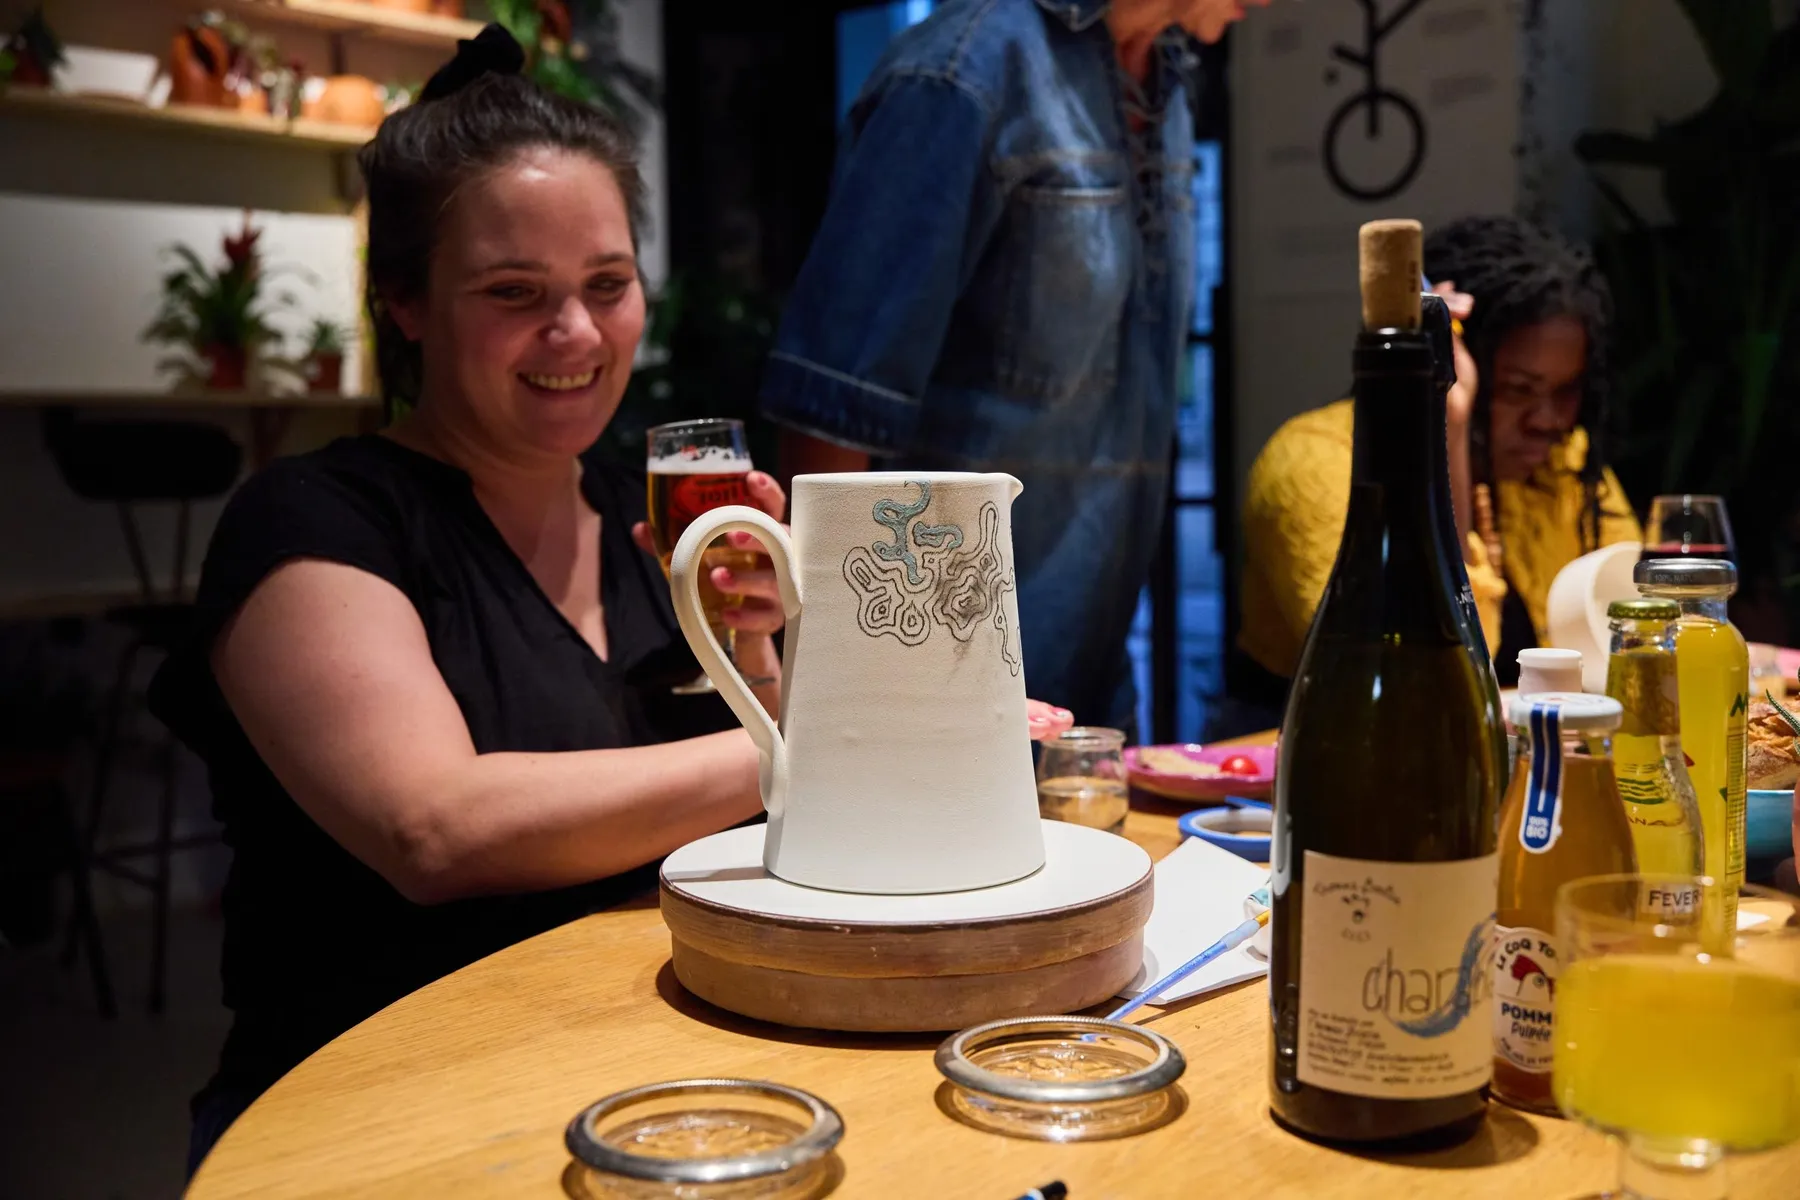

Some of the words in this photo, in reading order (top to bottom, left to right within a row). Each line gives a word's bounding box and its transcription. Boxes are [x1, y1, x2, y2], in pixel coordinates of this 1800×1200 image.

[1525, 825, 1548, 839] BIO
[1648, 888, 1700, 907] FEVER
[1504, 937, 1532, 955] COQ
[1537, 940, 1558, 959] TO
[1501, 1002, 1557, 1025] POMM
